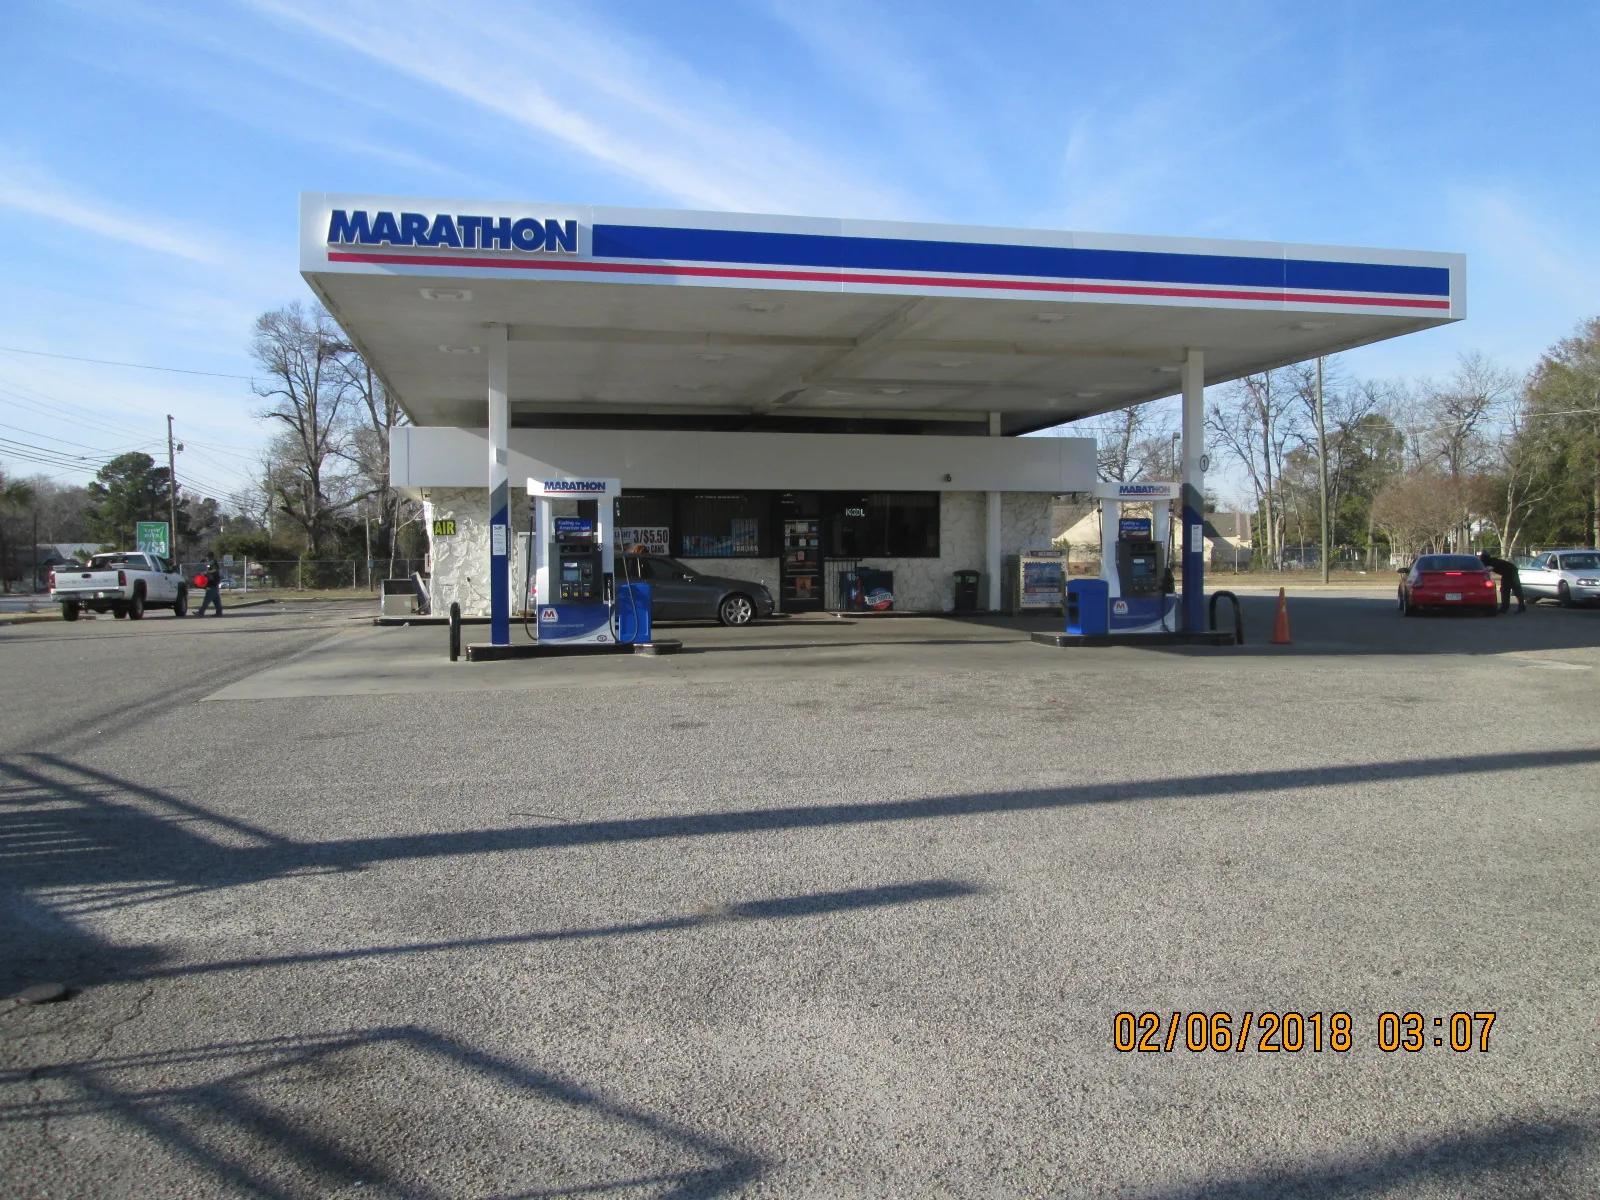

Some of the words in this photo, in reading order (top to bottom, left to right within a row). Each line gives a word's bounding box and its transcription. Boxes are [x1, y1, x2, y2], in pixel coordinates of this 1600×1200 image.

[328, 209, 578, 253] MARATHON
[544, 481, 606, 491] MARATHON
[1119, 485, 1171, 494] MARATHON
[845, 507, 866, 517] KOOL
[434, 521, 455, 535] AIR
[633, 529, 668, 544] 3/$5.50
